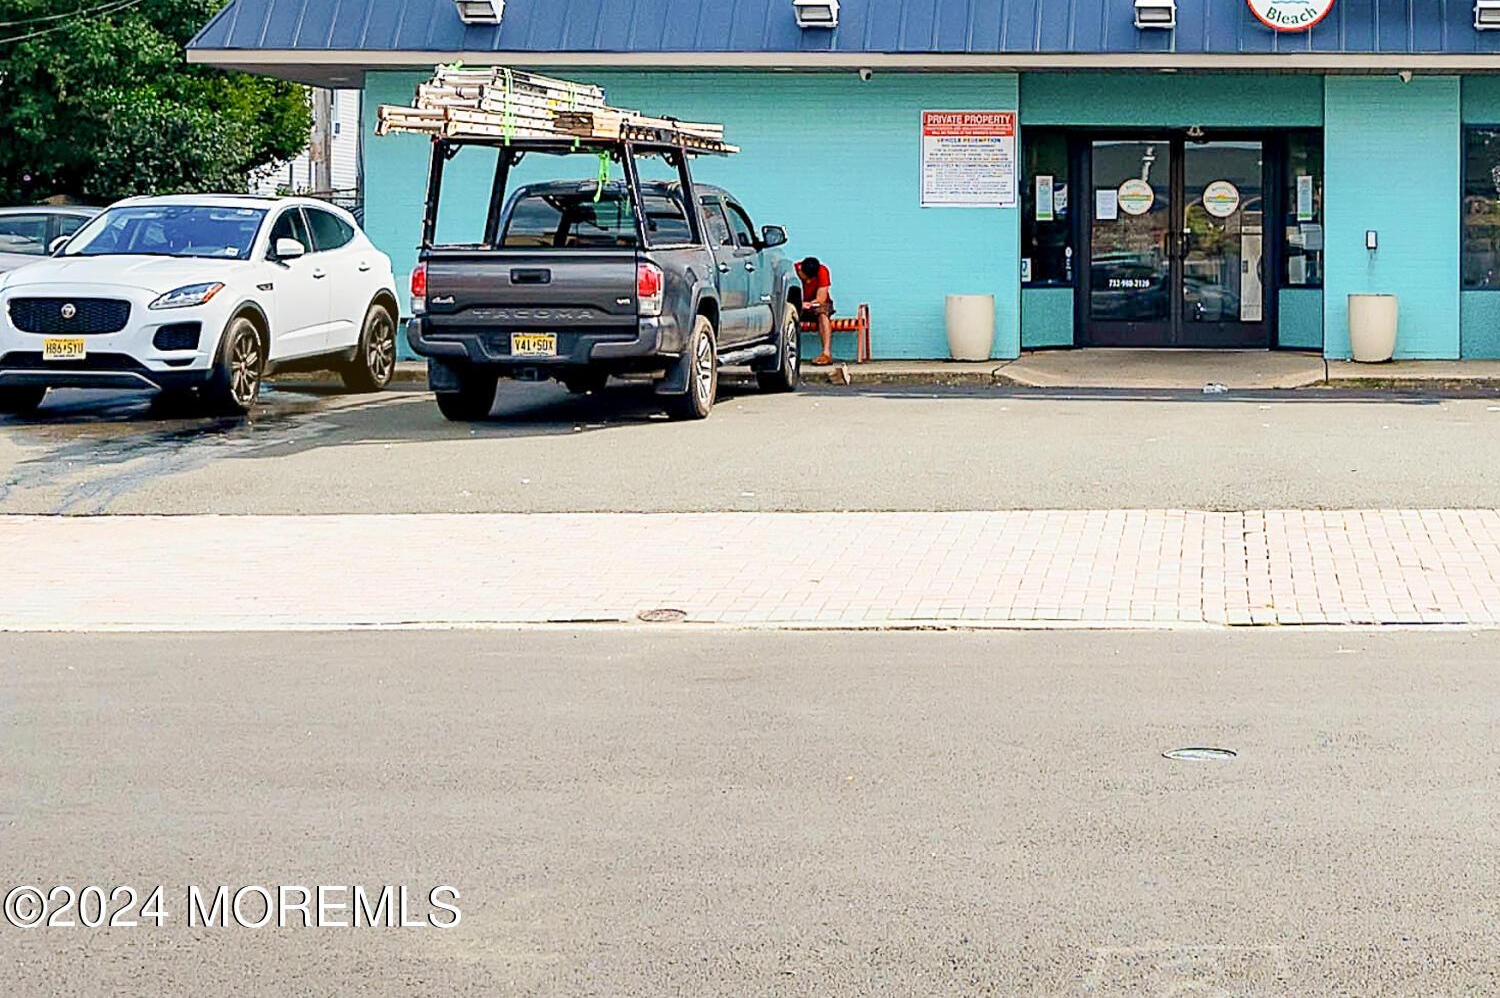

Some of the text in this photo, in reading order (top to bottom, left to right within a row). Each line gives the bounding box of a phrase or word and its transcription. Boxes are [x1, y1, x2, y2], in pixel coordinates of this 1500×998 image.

[1265, 6, 1318, 25] Bleach
[927, 114, 1011, 124] PRIVATE PROPERTY
[472, 309, 595, 320] TACOMA
